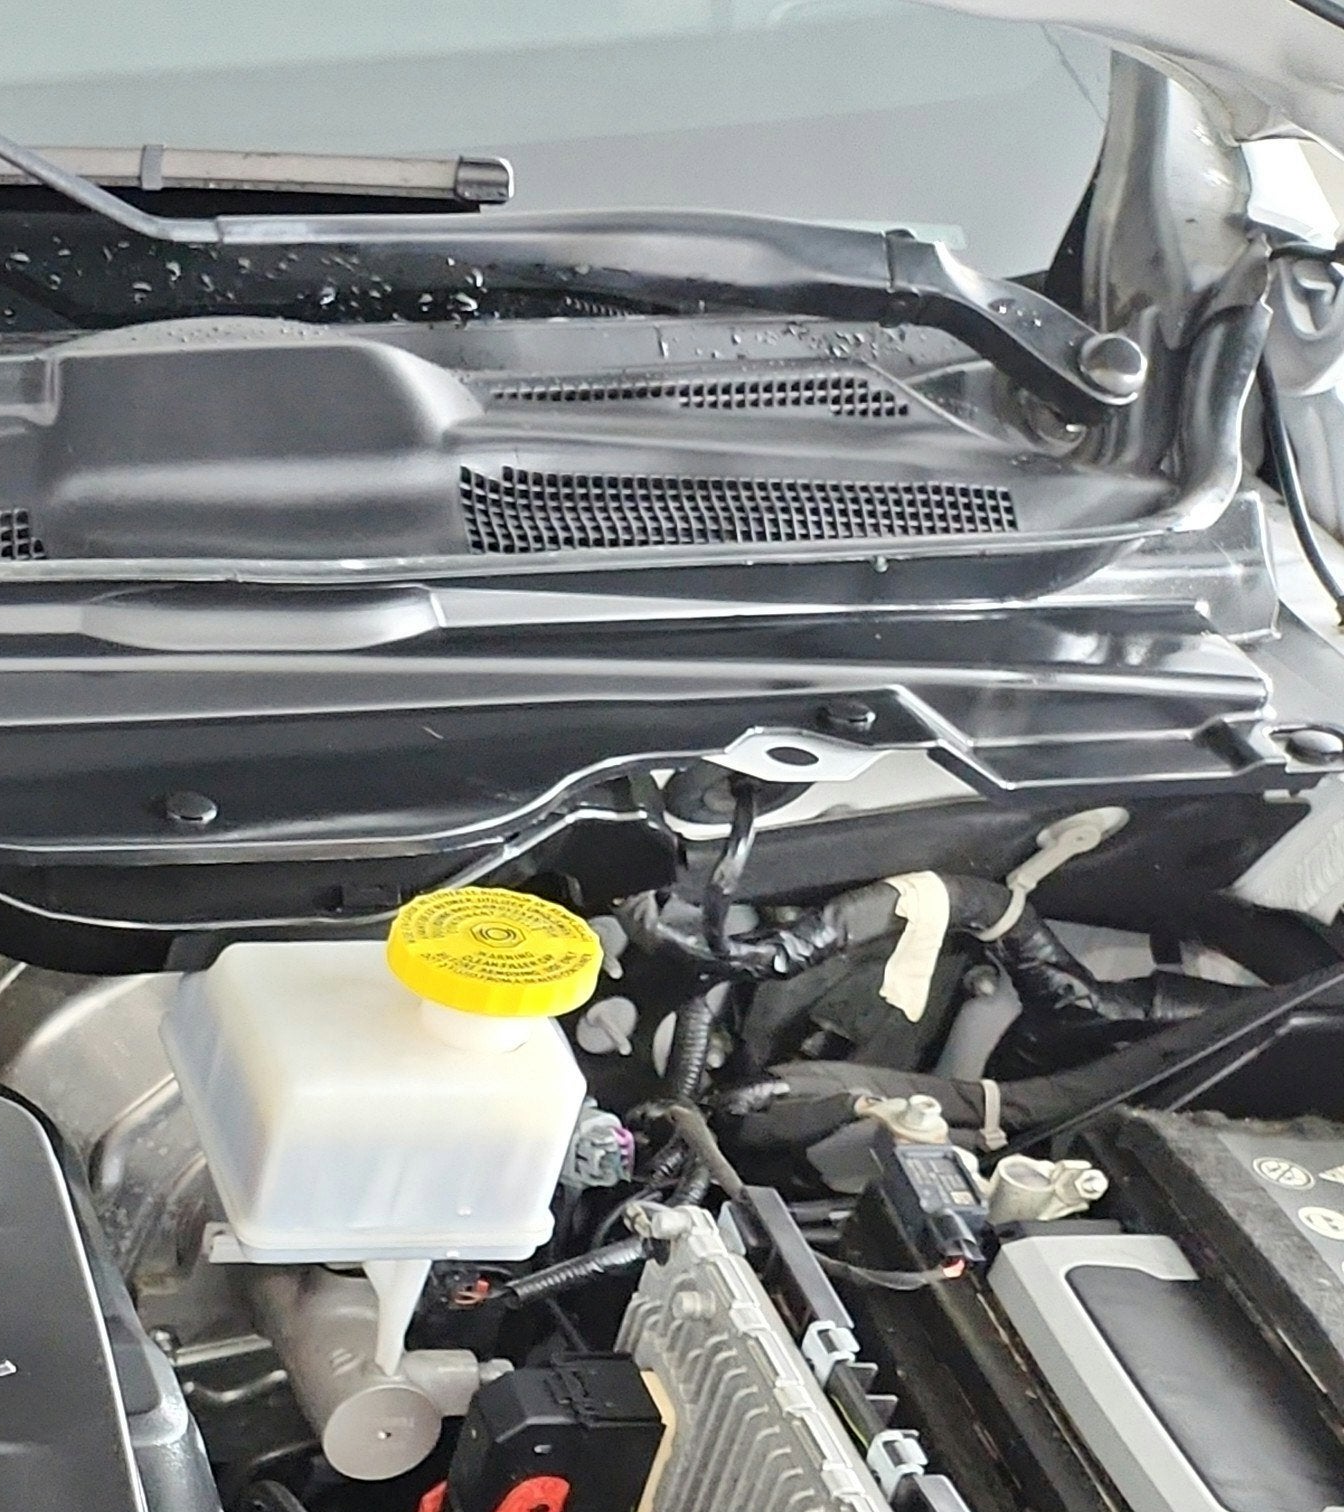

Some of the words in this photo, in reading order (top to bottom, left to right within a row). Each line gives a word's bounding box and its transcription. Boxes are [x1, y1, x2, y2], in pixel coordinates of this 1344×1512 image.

[475, 950, 536, 960] WARNING
[460, 954, 498, 968] CLEAN
[501, 960, 541, 969] FILLER
